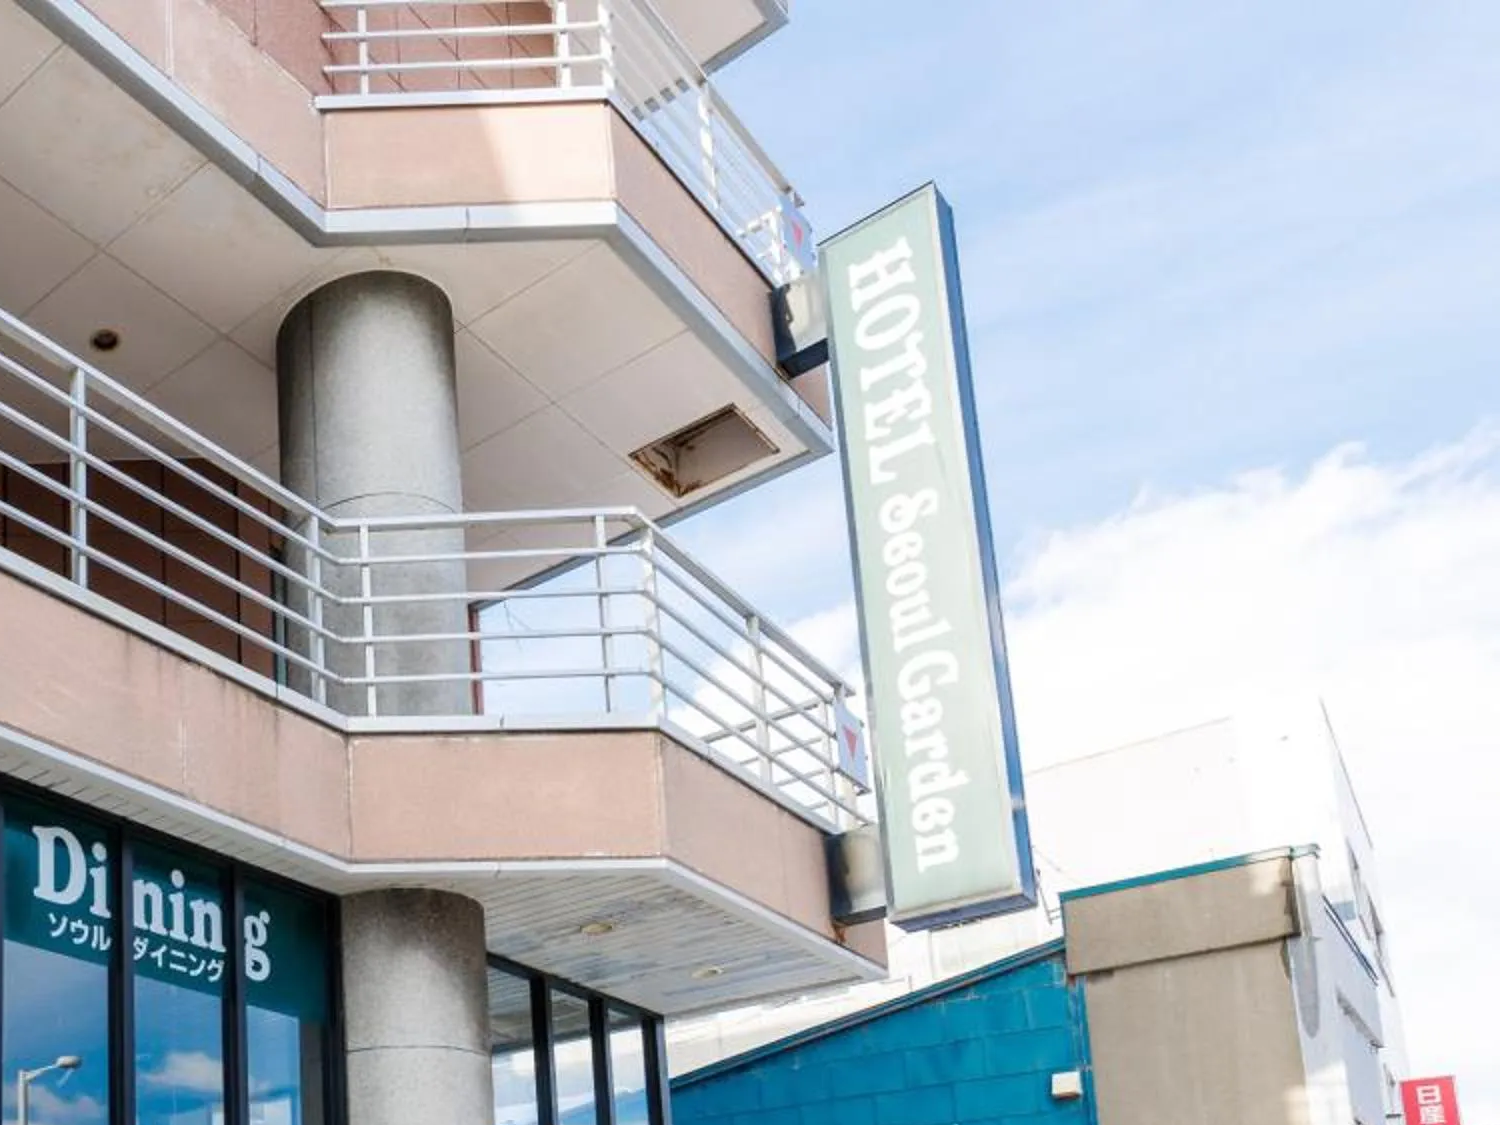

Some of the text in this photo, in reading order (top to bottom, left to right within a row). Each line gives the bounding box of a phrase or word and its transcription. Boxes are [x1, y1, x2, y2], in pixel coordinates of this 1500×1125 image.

[848, 236, 971, 874] HOTEL Seoul Garden
[32, 825, 272, 982] Dining
[48, 912, 225, 983] ソウル ダイニング
